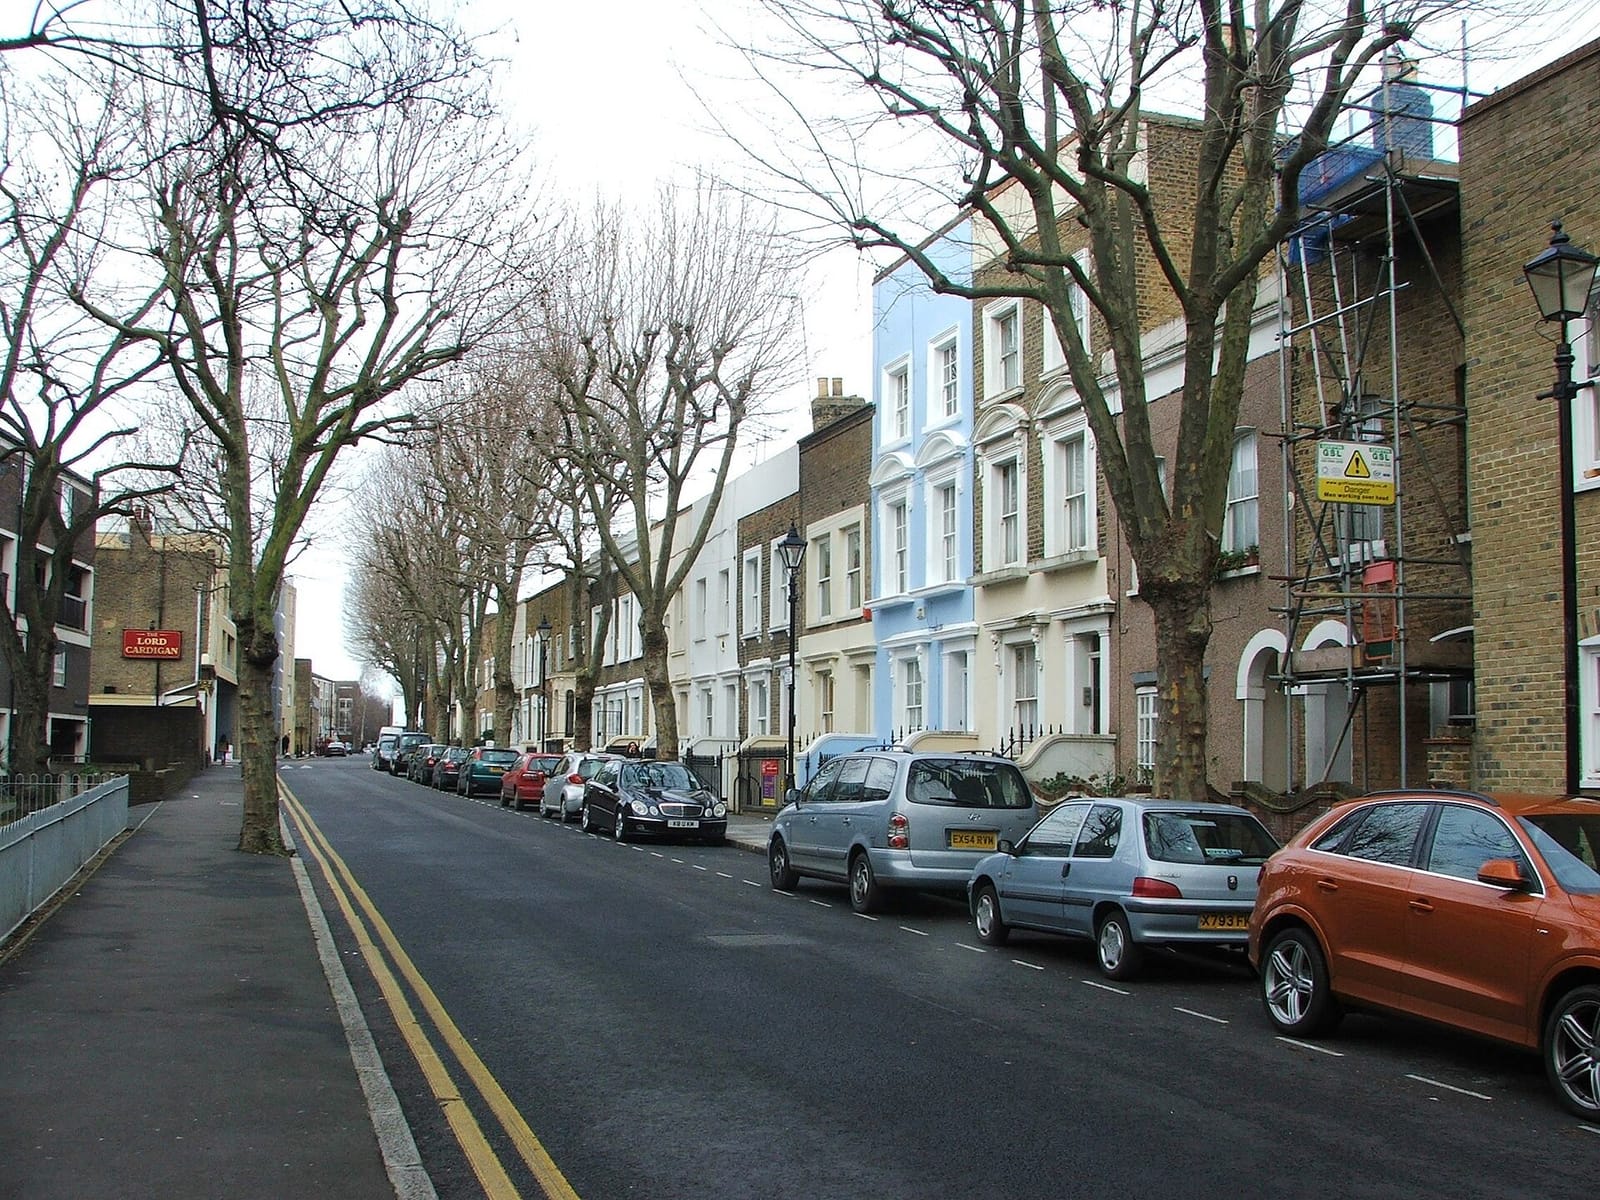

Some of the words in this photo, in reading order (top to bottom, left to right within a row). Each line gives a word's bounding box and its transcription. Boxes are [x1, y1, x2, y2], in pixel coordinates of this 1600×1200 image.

[1323, 449, 1342, 457] GSL
[1372, 453, 1390, 461] GSL
[1344, 485, 1370, 495] Danger
[1338, 492, 1361, 500] working
[137, 638, 167, 646] LORD
[125, 646, 179, 655] CARDIGAN
[953, 834, 975, 844] EX54
[1202, 914, 1234, 927] X793
